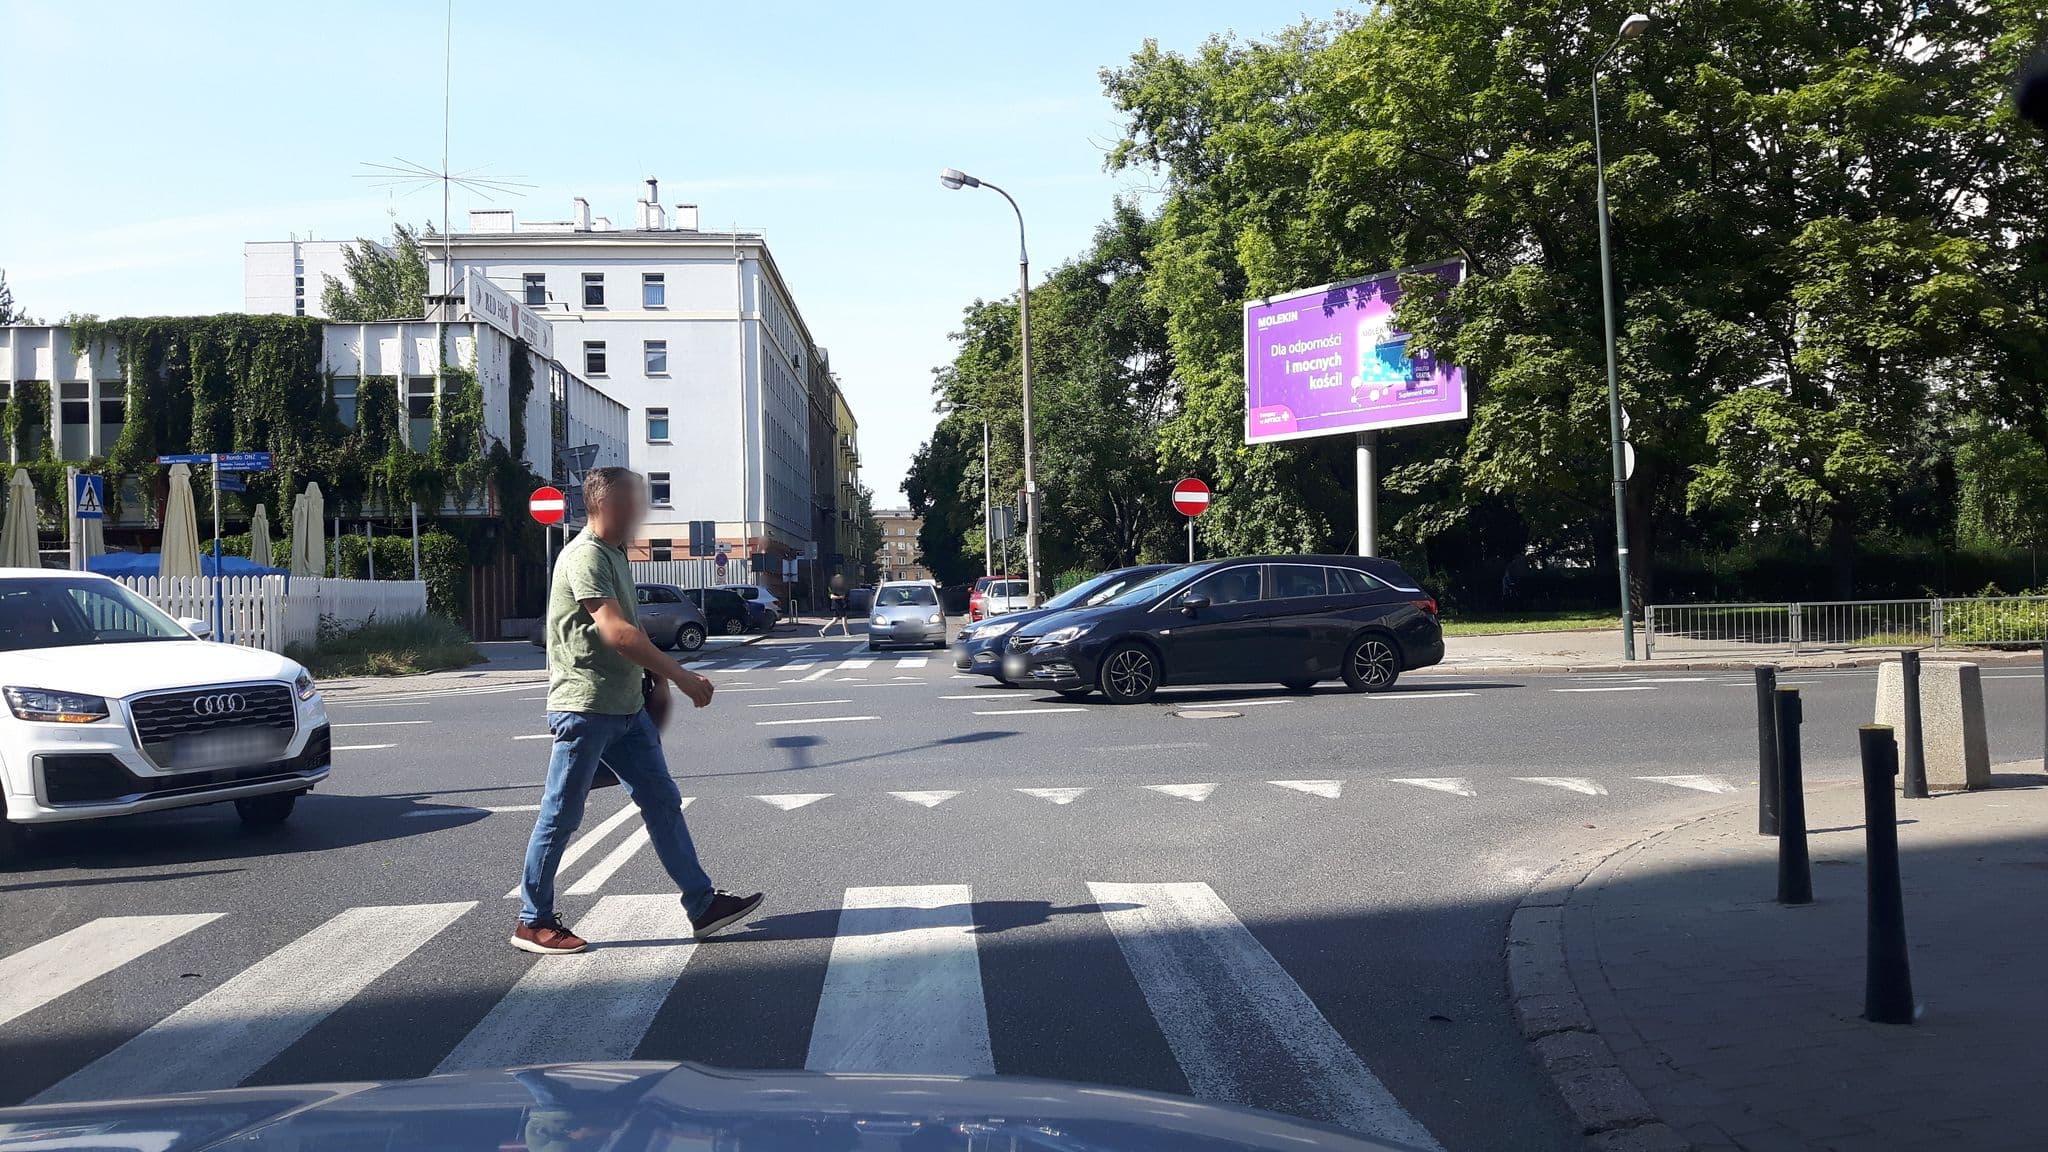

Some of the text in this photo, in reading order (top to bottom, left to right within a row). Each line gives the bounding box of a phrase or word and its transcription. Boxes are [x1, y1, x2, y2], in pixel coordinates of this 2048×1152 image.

[1257, 311, 1298, 328] MOLEKIN
[1271, 332, 1342, 357] Dla odporności
[1292, 351, 1342, 374] mocnych
[1309, 371, 1343, 390] kości!
